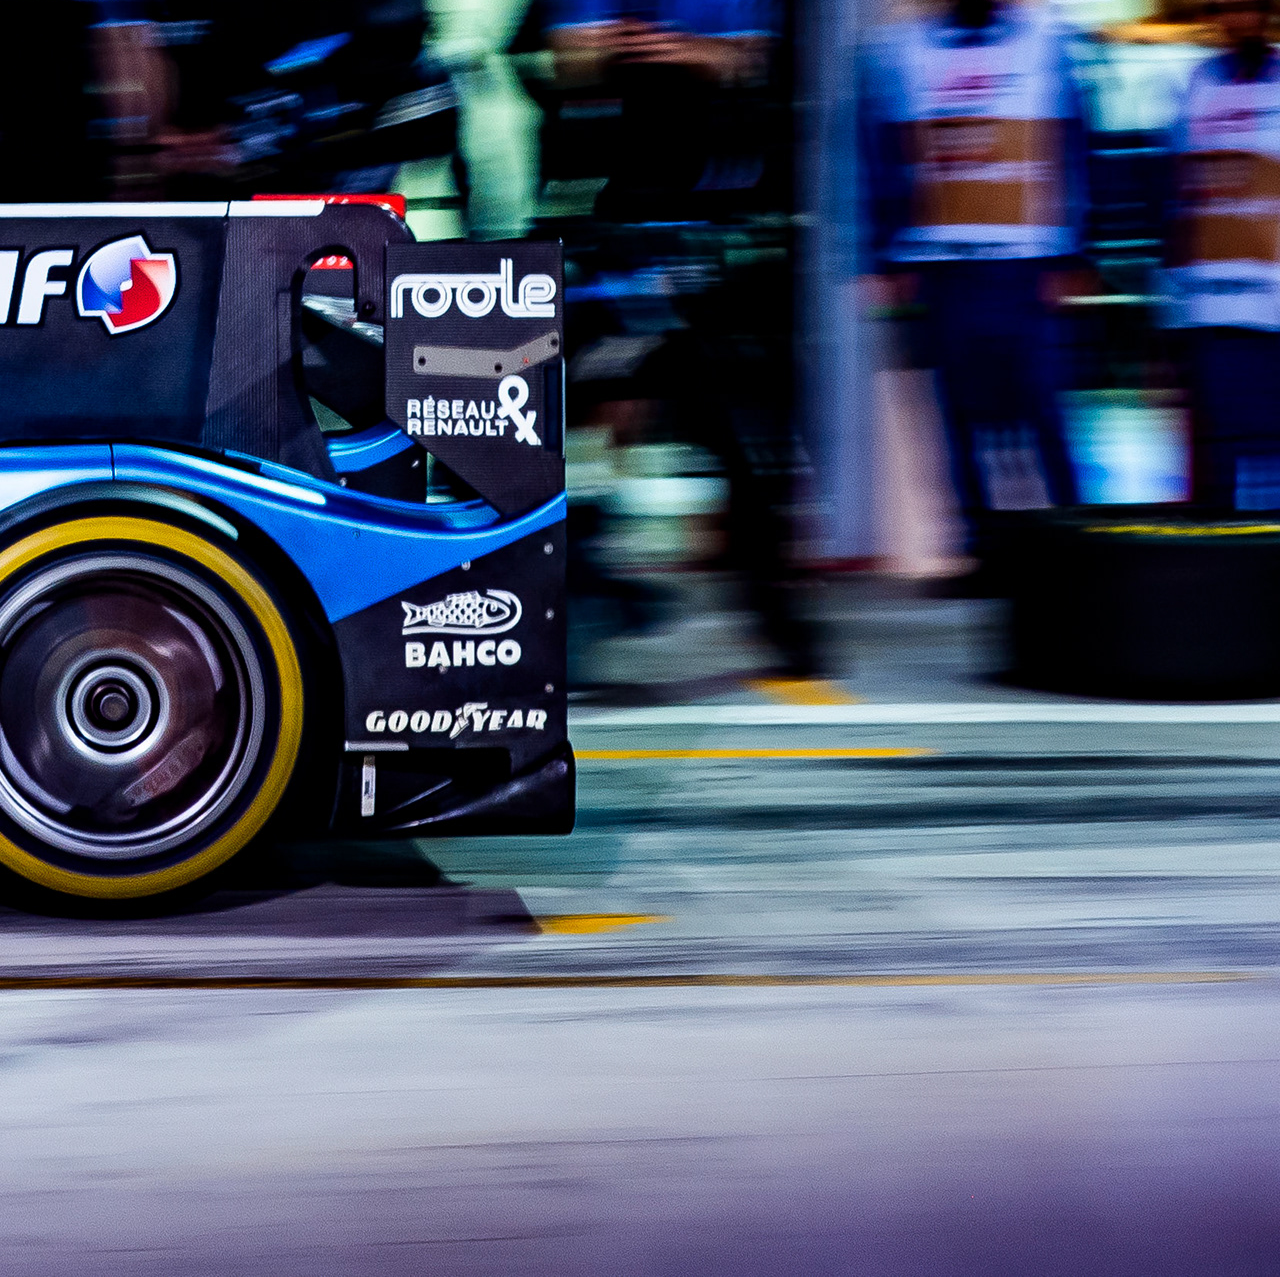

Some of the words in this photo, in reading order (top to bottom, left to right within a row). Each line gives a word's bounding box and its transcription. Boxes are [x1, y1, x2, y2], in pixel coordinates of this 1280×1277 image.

[390, 257, 557, 319] roole
[406, 395, 495, 419] RÉSEAU
[406, 419, 509, 437] RENAULT
[404, 639, 522, 668] BAHCO
[365, 701, 549, 740] GOODYEAR
